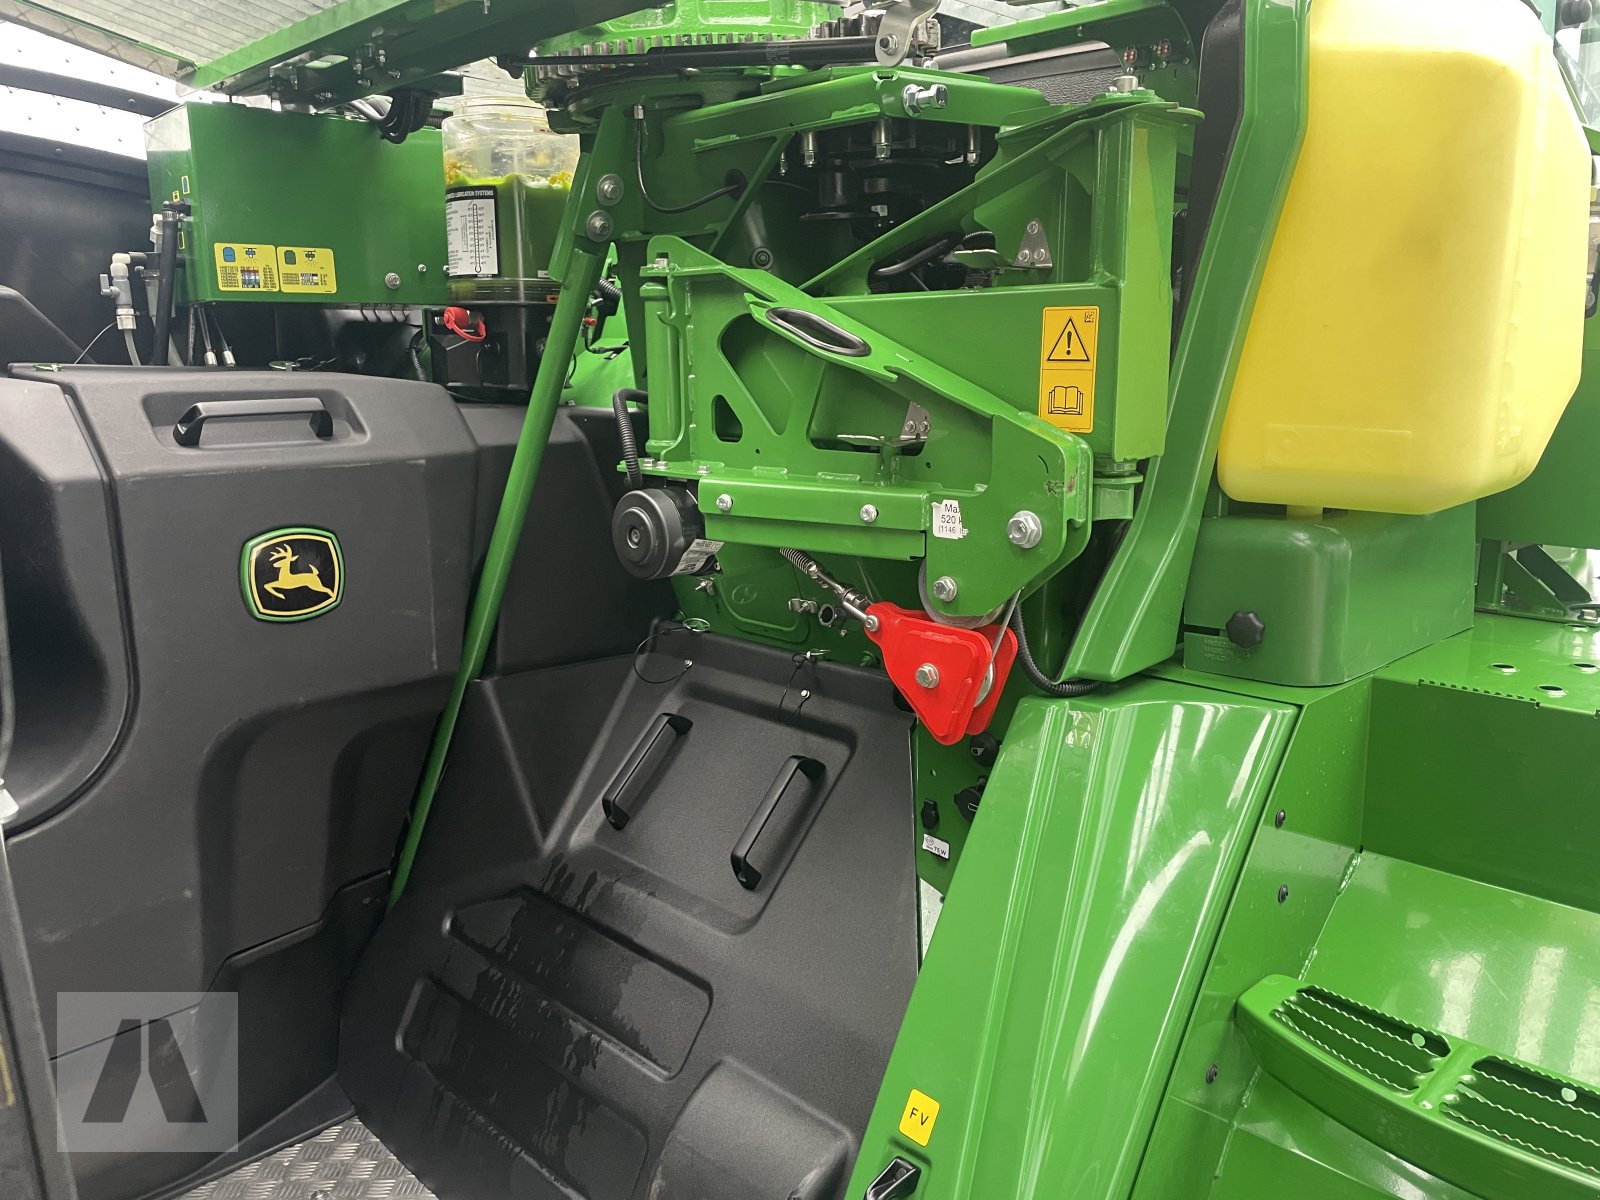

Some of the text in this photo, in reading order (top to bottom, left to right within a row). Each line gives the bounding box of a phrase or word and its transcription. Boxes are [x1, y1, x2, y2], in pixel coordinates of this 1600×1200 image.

[475, 189, 494, 197] SYSTEMS
[944, 503, 960, 514] Ma
[941, 514, 957, 525] 520
